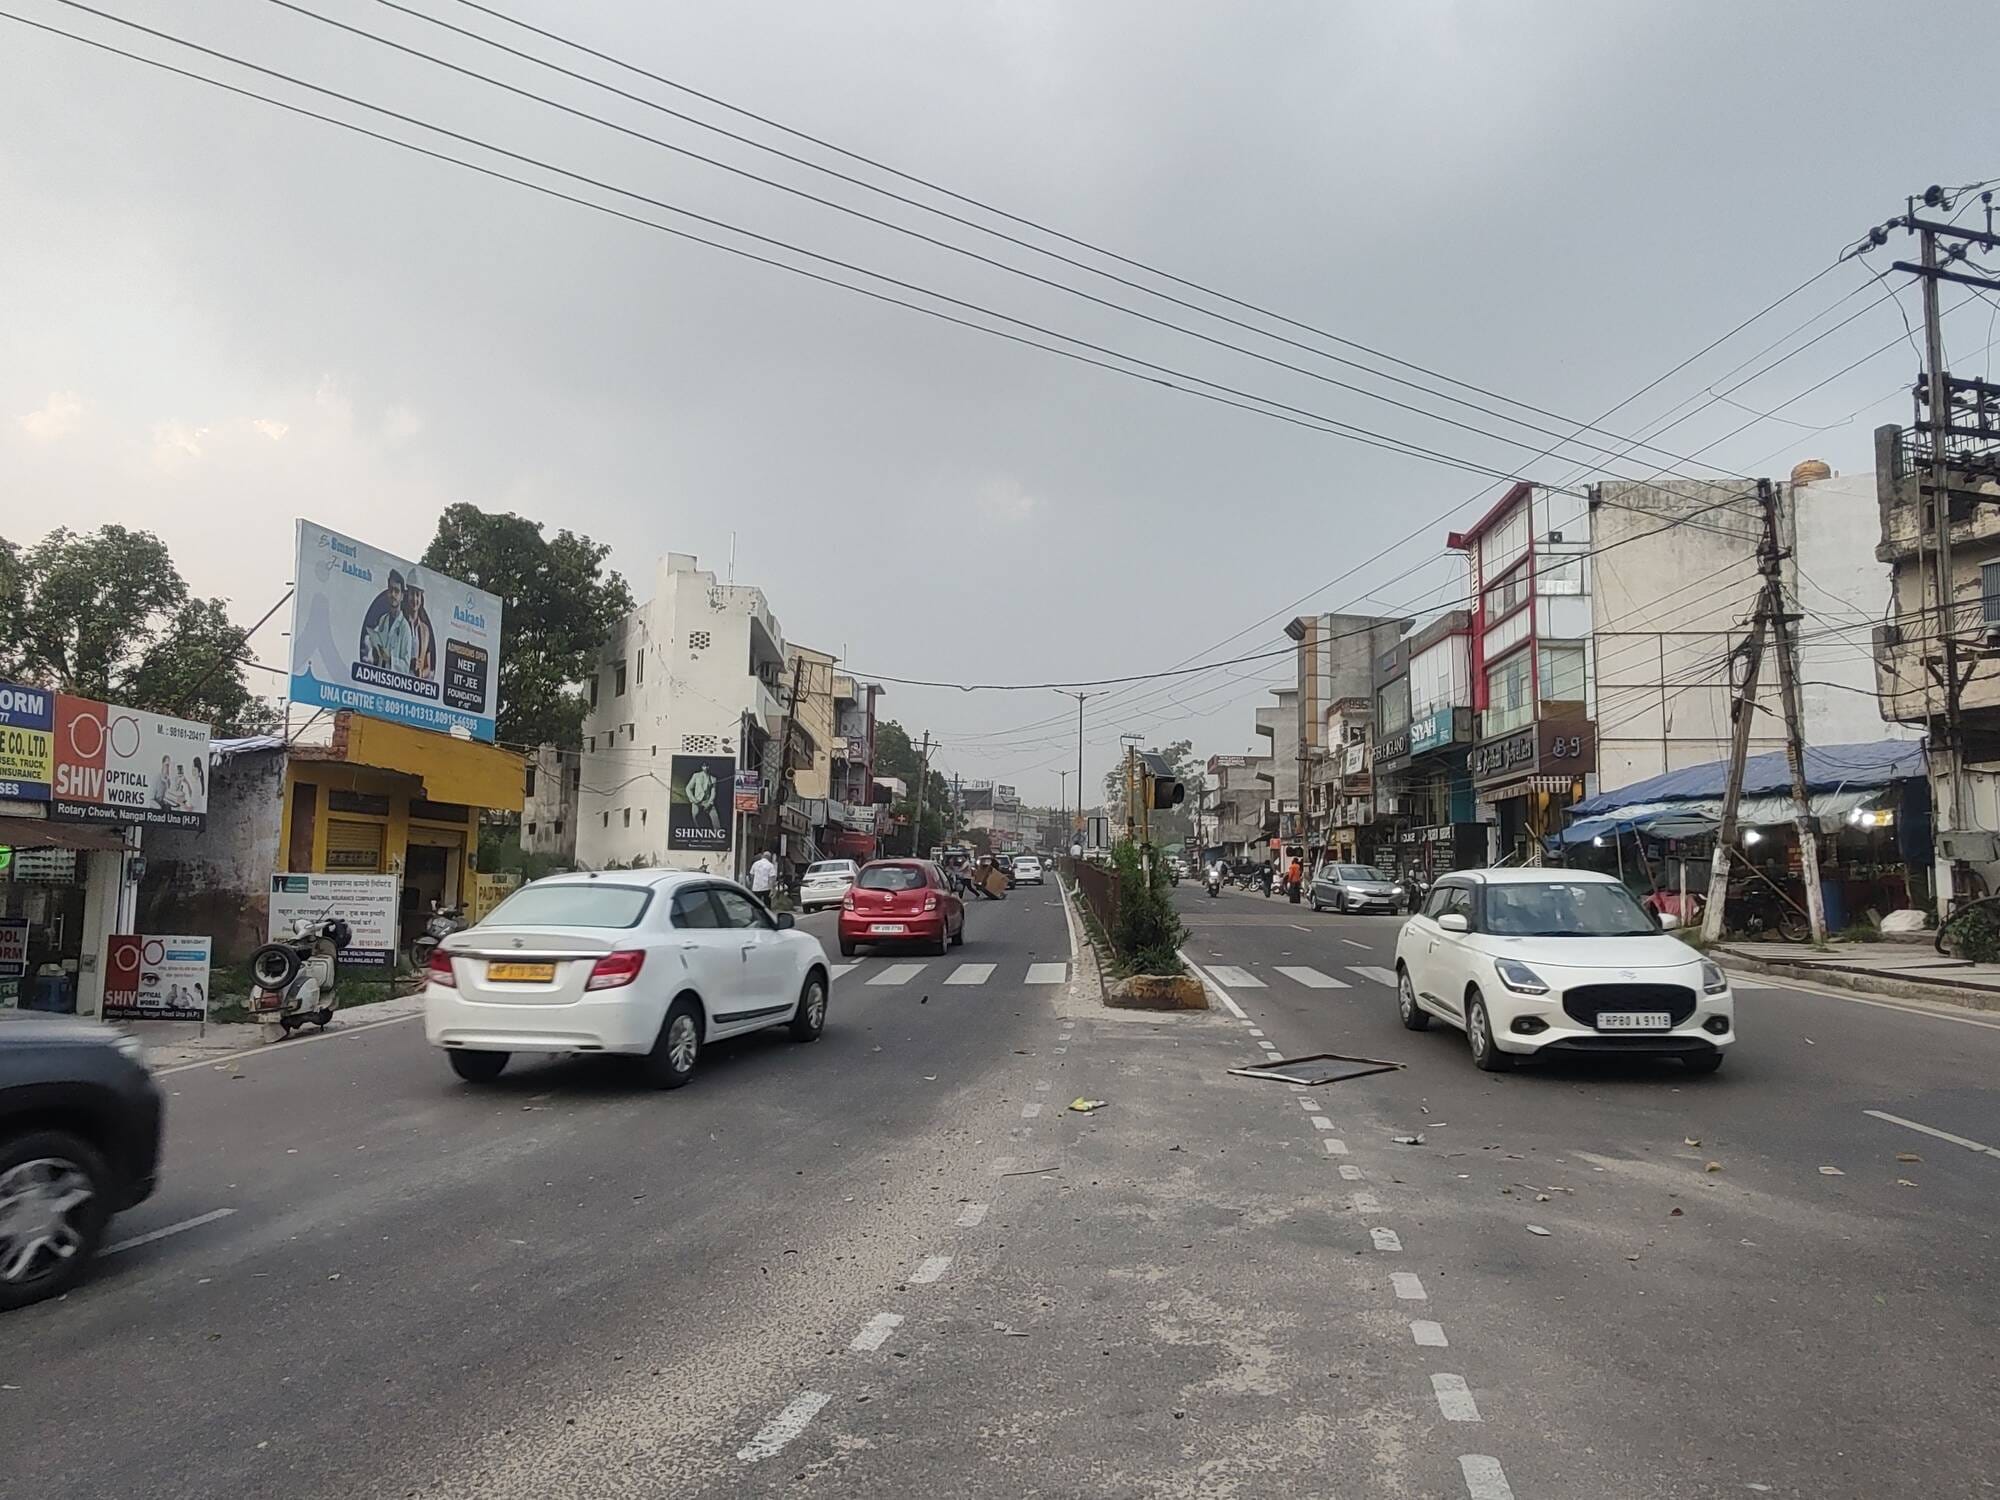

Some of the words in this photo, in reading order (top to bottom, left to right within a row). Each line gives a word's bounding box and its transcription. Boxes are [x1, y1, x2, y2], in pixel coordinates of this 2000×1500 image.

[342, 560, 372, 582] Aakash
[453, 605, 485, 628] Aakash
[457, 658, 476, 673] NEET
[356, 666, 412, 692] ADMISSIONS
[413, 681, 437, 697] OPEN
[320, 685, 340, 702] UNA
[341, 690, 374, 710] CENTRE
[447, 688, 482, 704] FOUNDATION
[8, 731, 25, 756] CO.
[28, 734, 48, 758] LTD.
[20, 759, 46, 770] TRUCK,
[56, 763, 104, 798] SHIV
[106, 770, 148, 787] OPTICAL
[108, 788, 145, 804] WORKS
[57, 803, 86, 817] Rotary
[88, 806, 117, 820] Chowk,
[119, 810, 146, 822] Nangal
[147, 812, 166, 823] Road
[167, 814, 181, 824] Una
[675, 828, 726, 839] SHINING
[105, 990, 137, 1006] SHIV
